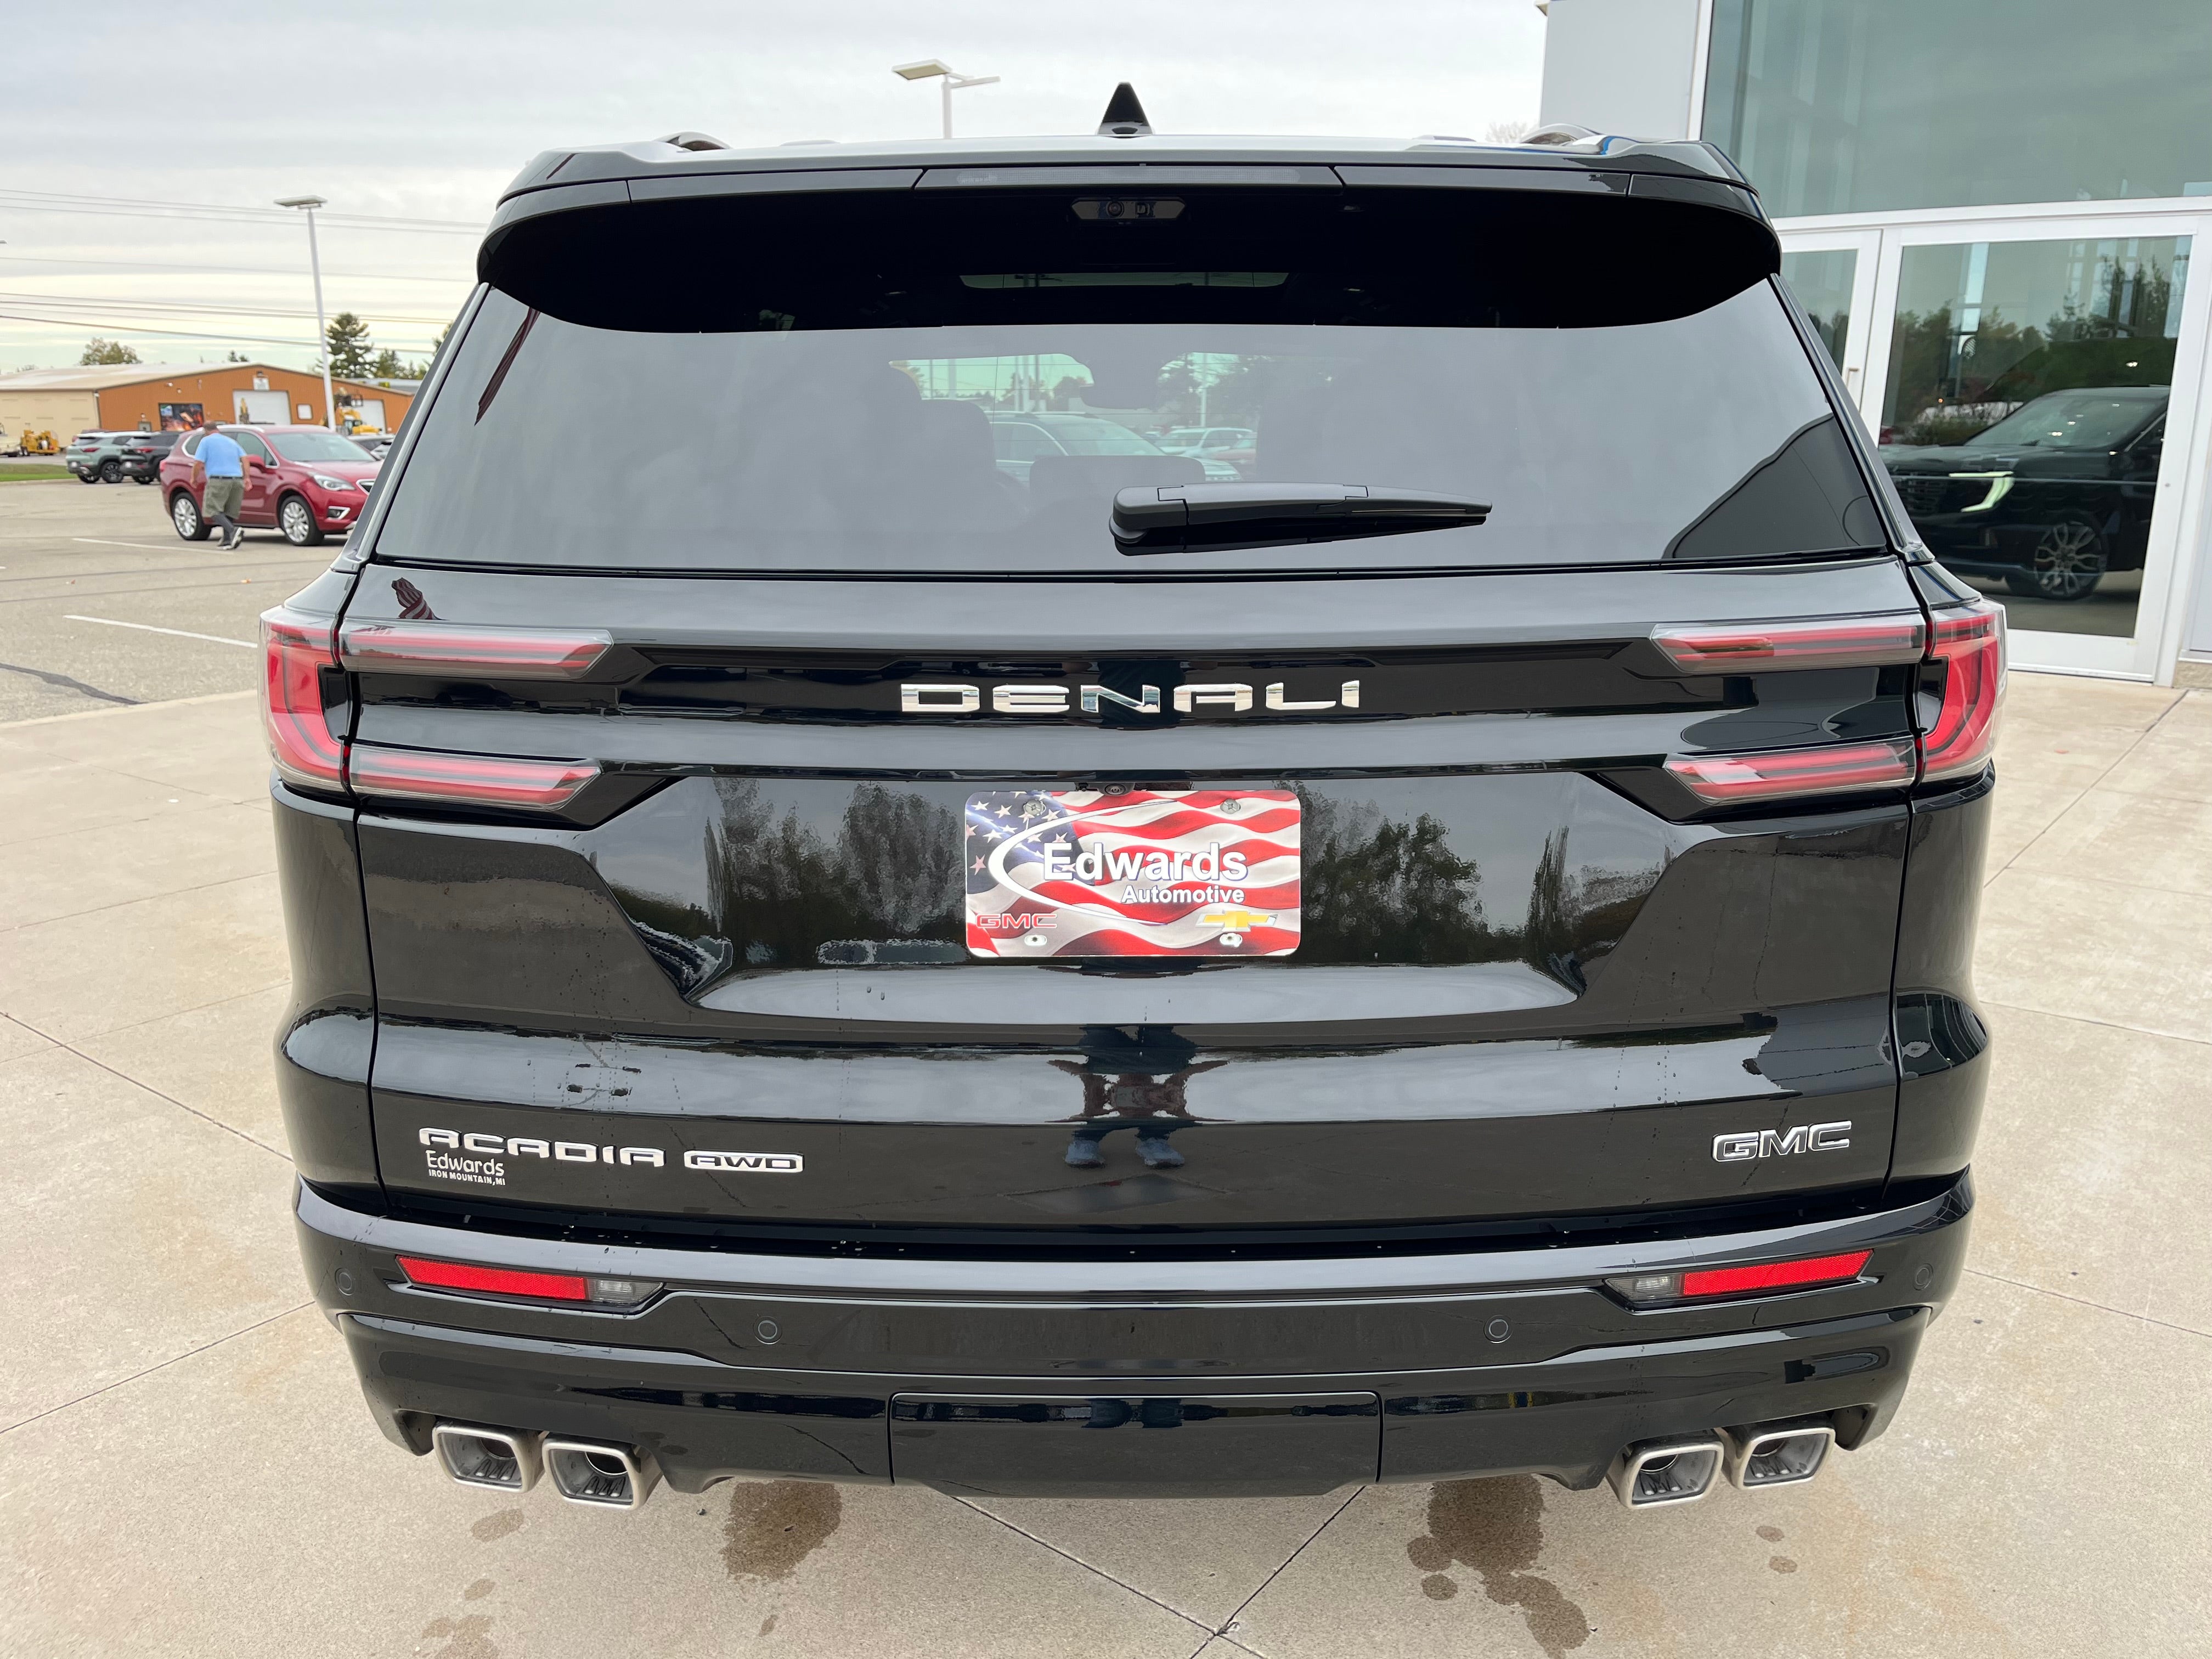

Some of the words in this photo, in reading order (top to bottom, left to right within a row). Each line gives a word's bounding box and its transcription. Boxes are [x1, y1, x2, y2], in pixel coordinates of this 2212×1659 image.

[901, 680, 1360, 713] DENALI
[1043, 842, 1249, 882] Edwards
[1120, 884, 1245, 905] Automotive
[975, 912, 1058, 929] GMC
[419, 1127, 667, 1167] ACADIA
[689, 1153, 798, 1170] AWD
[1712, 1120, 1852, 1162] GMC
[425, 1149, 505, 1177] Edwards
[428, 1169, 448, 1179] IRON
